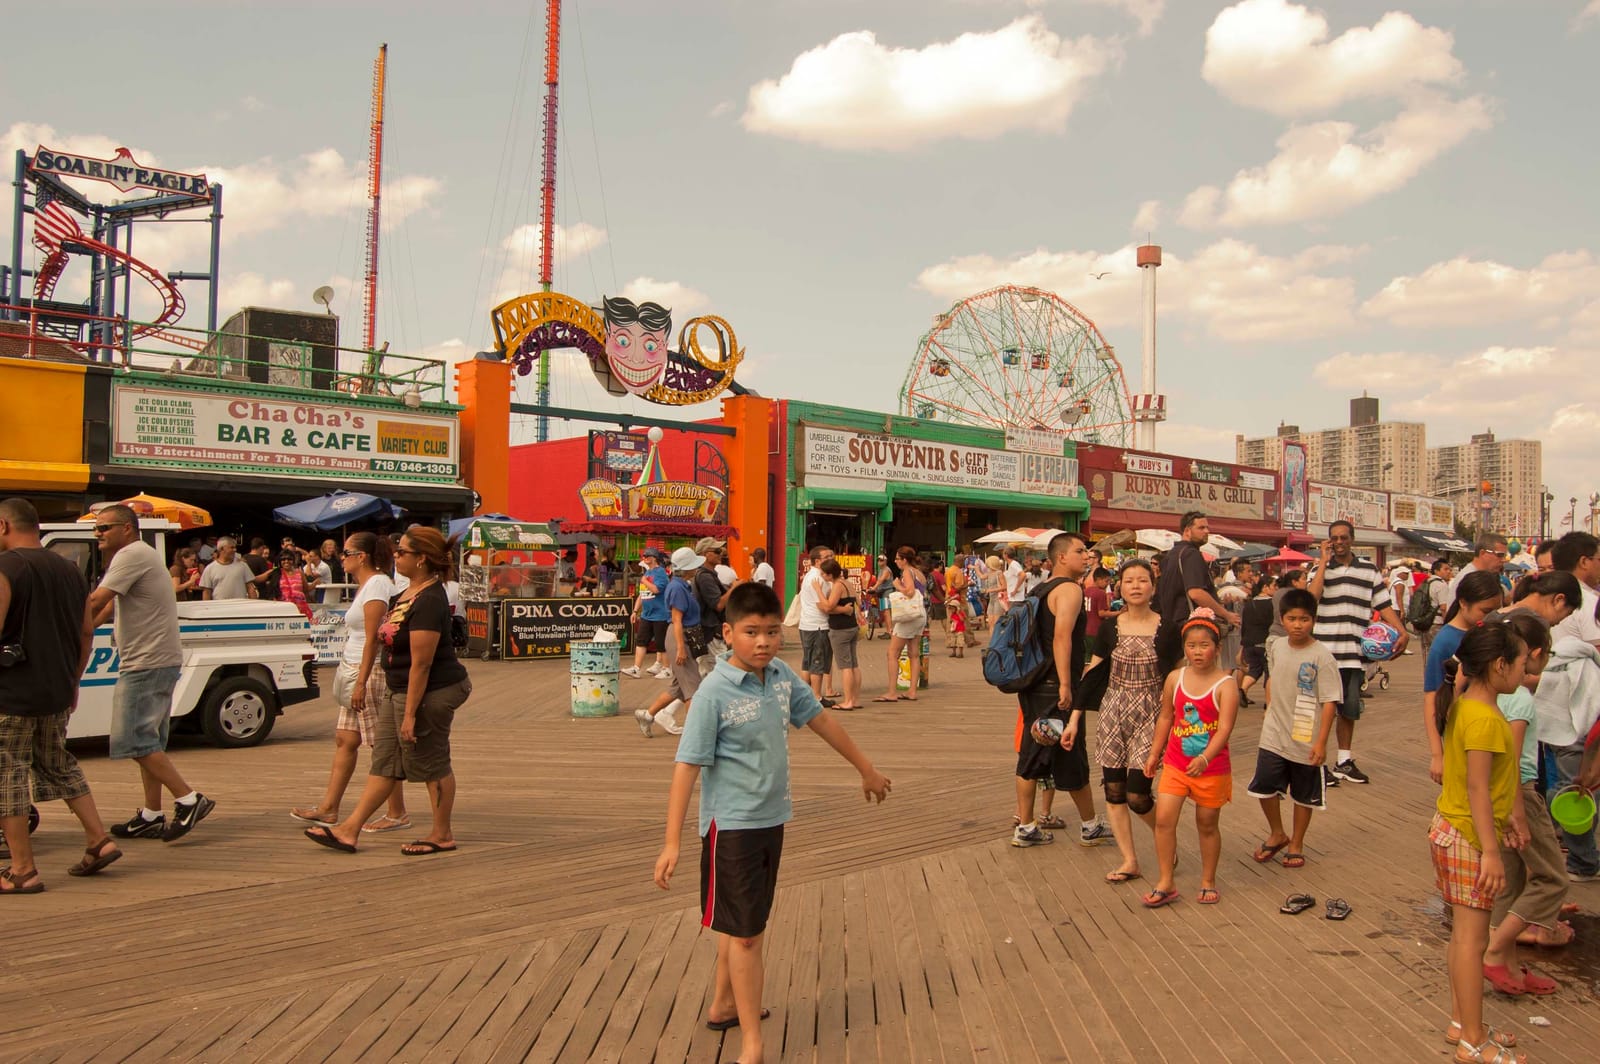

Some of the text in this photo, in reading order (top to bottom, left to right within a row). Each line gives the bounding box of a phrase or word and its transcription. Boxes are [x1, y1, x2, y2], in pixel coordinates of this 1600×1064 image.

[36, 151, 207, 195] SOARIN' EAGLE
[170, 400, 192, 408] CLAMS
[228, 400, 365, 429] Cha Cha's
[139, 416, 194, 427] ICE COLD OYSTERS
[147, 425, 158, 433] THE
[177, 427, 194, 435] SHELL
[138, 435, 194, 446] SHRIMP COCKTAIL
[217, 423, 270, 445] BAR
[281, 428, 298, 448] &
[307, 430, 371, 452] CAFE
[809, 432, 845, 444] UMBRELLAS
[381, 437, 447, 455] VARIETY CLUB
[814, 443, 840, 453] CHAIRS
[121, 444, 368, 470] Live Entertainment For The Hole Family
[811, 453, 846, 463] FOR RENT
[965, 451, 989, 467] GIFT
[990, 454, 1017, 464] BATTERIES
[374, 460, 453, 474] 718/946-1305
[966, 465, 989, 476] SHOP
[992, 462, 1016, 473] T-SHIRTS
[1022, 453, 1078, 486] ICE CREAM
[1138, 459, 1162, 471] RUBY'S
[830, 465, 850, 474] TOYS
[860, 467, 878, 476] FILM
[886, 470, 910, 479] SUNTAN
[928, 474, 965, 484] SUNGLASSES
[970, 478, 989, 487] BEACH
[990, 480, 1011, 489] TOWELS
[992, 472, 1016, 481] SANDALS
[669, 484, 709, 501] COLADAS
[1125, 474, 1171, 497] RUBY'S
[1177, 481, 1202, 500] BAR
[1208, 485, 1218, 502] &
[1223, 487, 1257, 505] GRILL
[651, 504, 697, 518] DAIQUIRIS
[834, 555, 866, 568] UVENIRS
[512, 603, 629, 618] PINA COLADA
[512, 624, 550, 634] Strawberry
[551, 624, 576, 633] Daquiri
[603, 622, 626, 630] Daquiri
[535, 632, 567, 640] Hawaiian
[569, 631, 594, 639] Banana
[527, 643, 561, 655] Free
